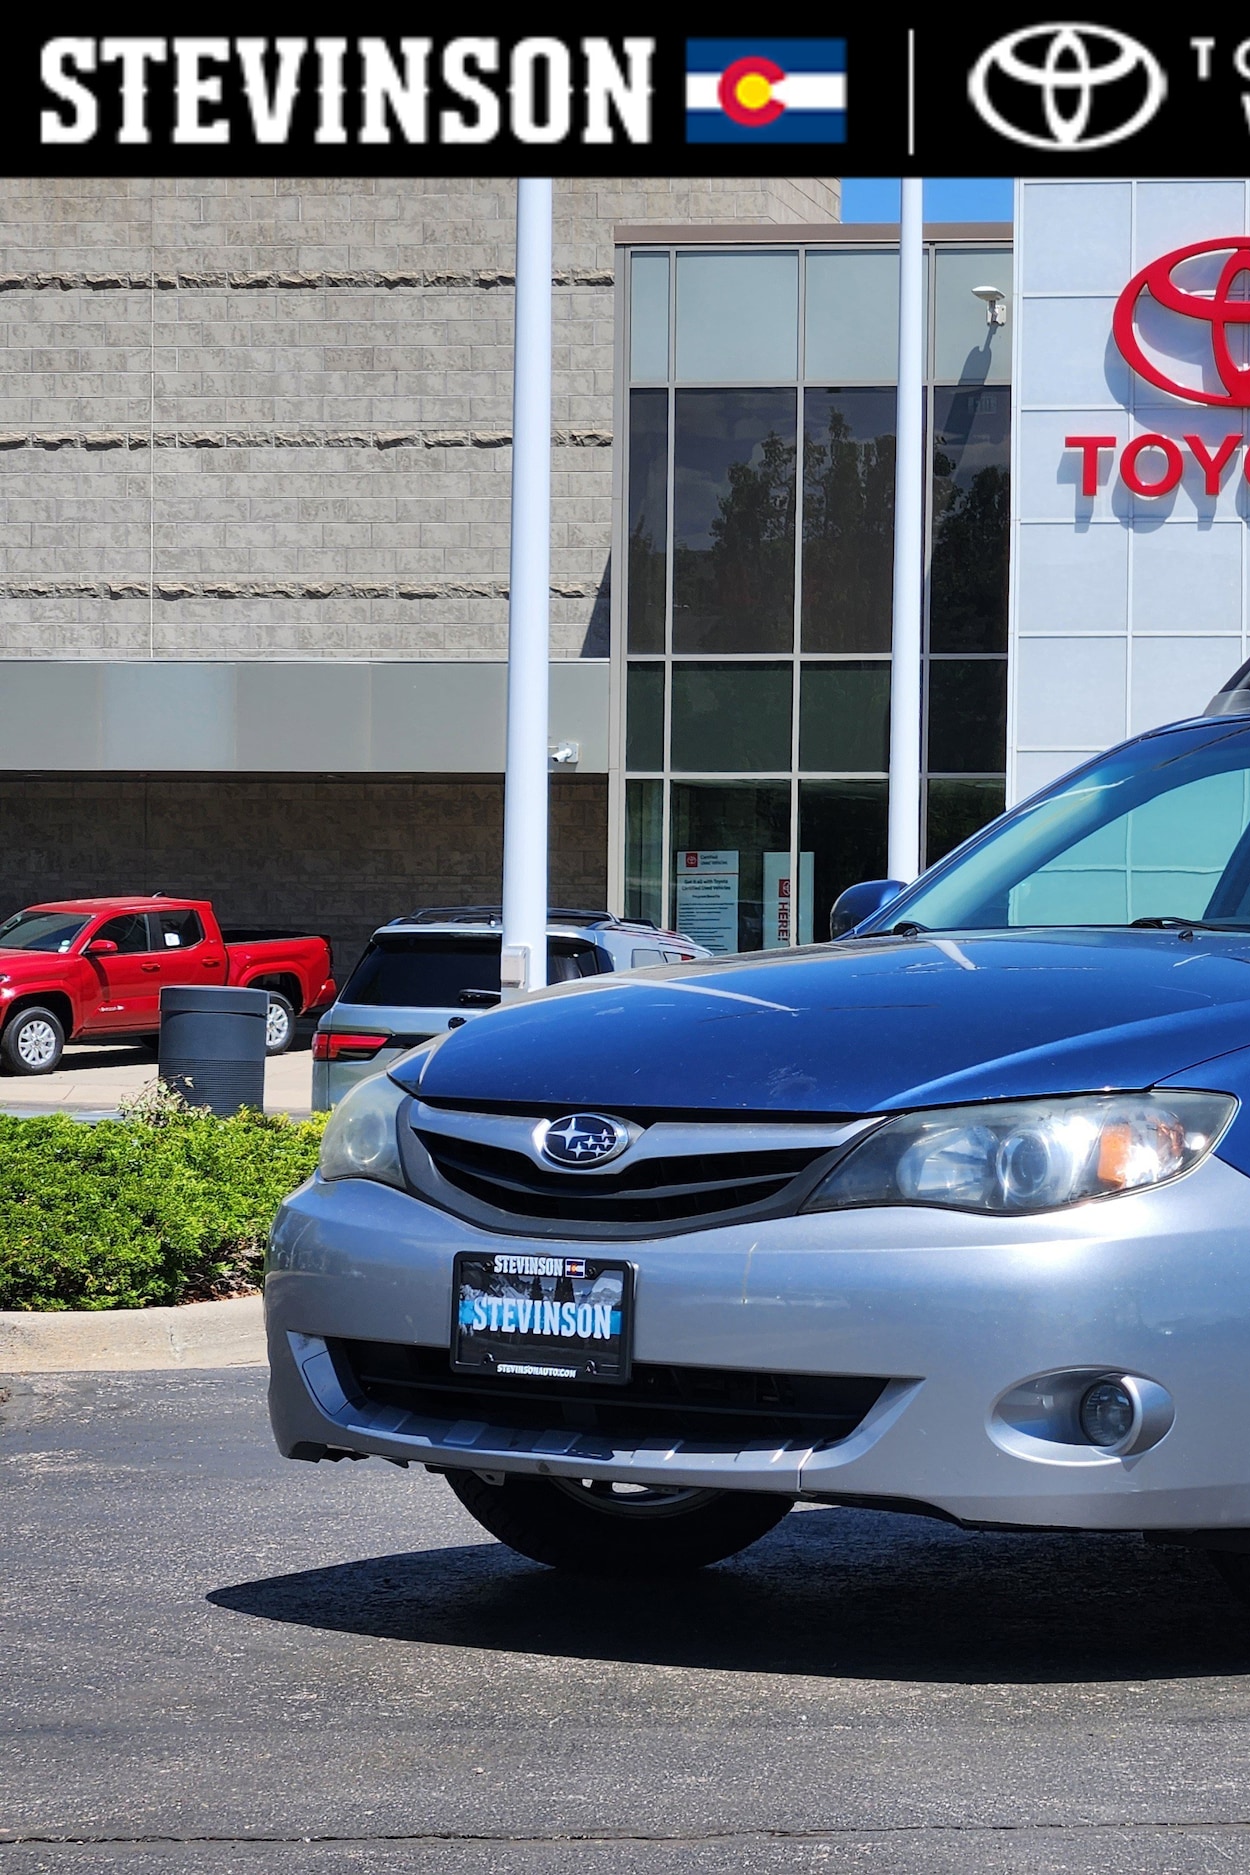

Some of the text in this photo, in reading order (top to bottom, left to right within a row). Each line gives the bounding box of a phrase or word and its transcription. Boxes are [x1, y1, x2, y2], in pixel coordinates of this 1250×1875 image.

[777, 902, 789, 941] HERE!
[493, 1254, 564, 1277] STEVINSON
[472, 1296, 613, 1341] STEVINSON
[496, 1363, 577, 1379] STEVINSONAUTO.COM
